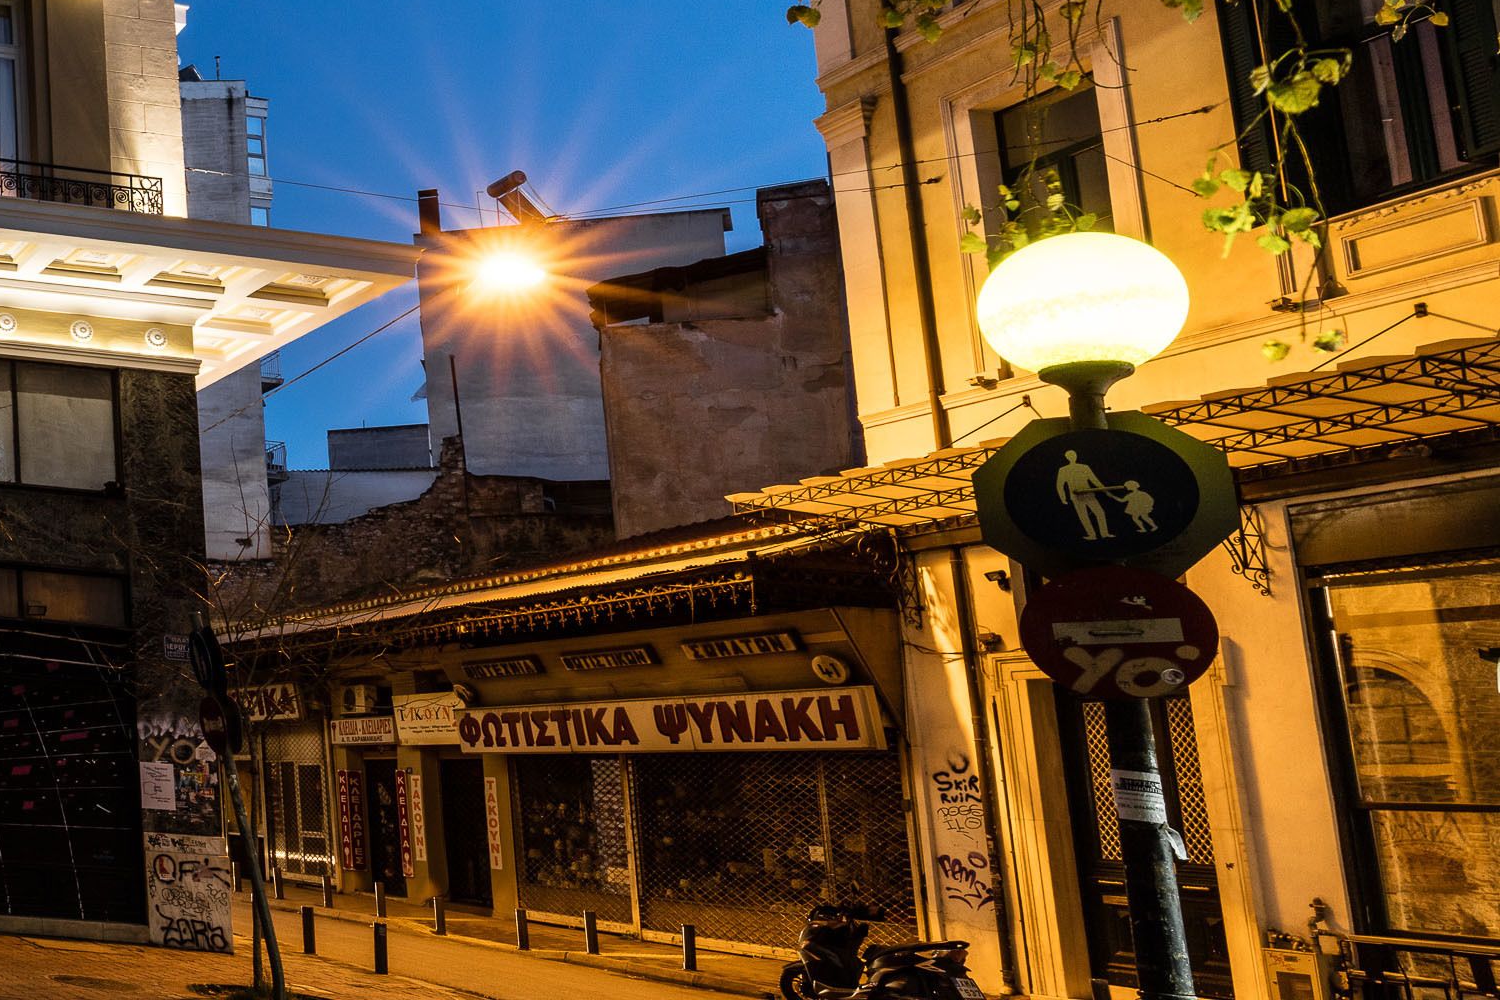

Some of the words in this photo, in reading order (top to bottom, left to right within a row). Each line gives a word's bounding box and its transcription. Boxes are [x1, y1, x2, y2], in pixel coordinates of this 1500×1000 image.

[689, 634, 787, 659] ΣΩΜΑΤΩΝ
[816, 662, 842, 678] 41
[459, 707, 640, 747] ΦΩΤΙΣΤΙΚΑ
[653, 695, 861, 744] ΨΥΝΑΚΗ
[339, 776, 350, 843] ΚΛΕΙΔΙΑ
[349, 777, 364, 865] ΚΛΕΙΔΑΡΙΕΣ
[397, 776, 410, 848] ΚΛΕΙΔΙΑ
[412, 778, 424, 858] ΤΑΚΟΥΝΙ
[486, 780, 500, 866] ΤΑΚΟΥΝΙ
